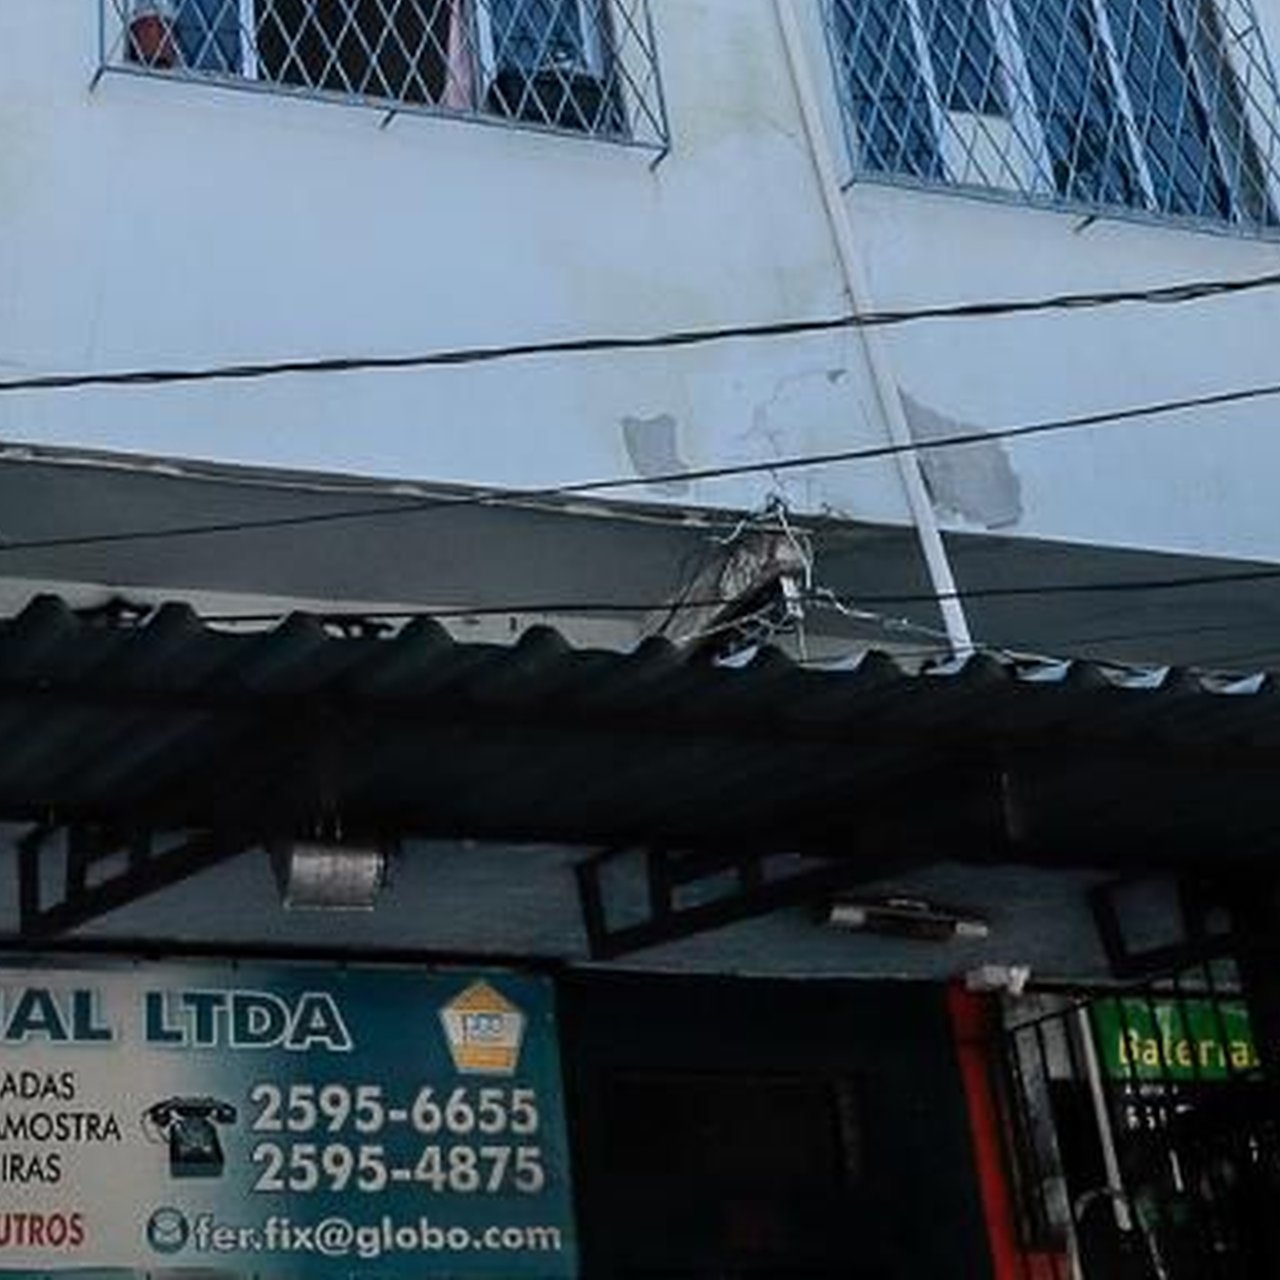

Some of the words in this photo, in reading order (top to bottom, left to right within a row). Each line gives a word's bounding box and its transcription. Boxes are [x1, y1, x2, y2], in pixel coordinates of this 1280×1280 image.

[143, 987, 356, 1053] LTDA
[1118, 1028, 1265, 1070] Bateria
[250, 1084, 540, 1136] 2595-6655
[250, 1142, 546, 1194] 2595-4875
